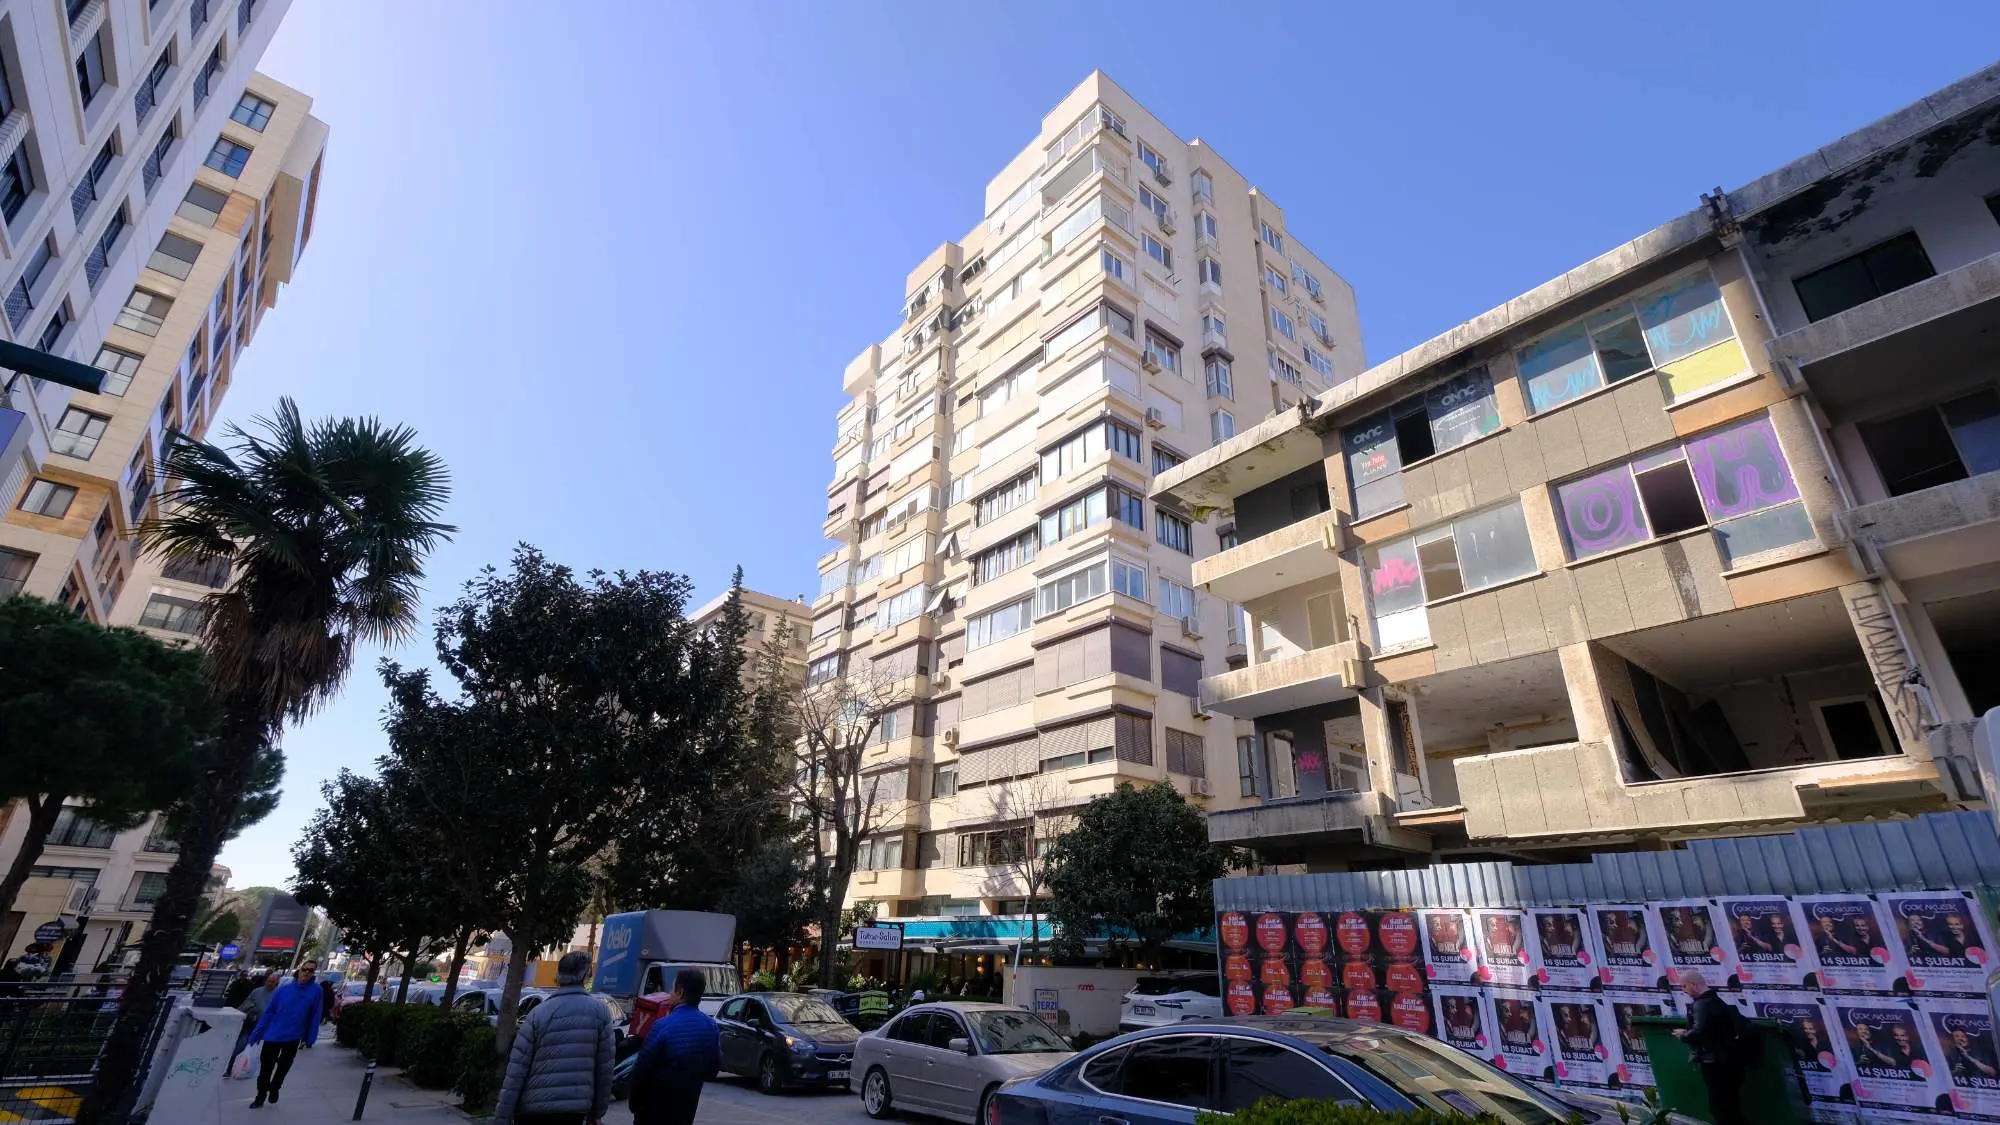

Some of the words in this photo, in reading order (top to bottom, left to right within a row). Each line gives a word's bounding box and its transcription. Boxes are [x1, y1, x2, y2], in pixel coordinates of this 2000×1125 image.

[607, 924, 632, 949] beko
[1753, 953, 1784, 962] ŞUBAT
[1821, 957, 1833, 965] 14
[1836, 957, 1870, 967] ŞUBAT
[1924, 957, 1966, 967] ŞUBAT
[1456, 1040, 1476, 1048] ŞUBAT
[1511, 1045, 1533, 1054] ŞUBAT
[1573, 1052, 1596, 1060] ŞUBAT
[1858, 1067, 1871, 1075] 14
[1873, 1068, 1912, 1079] ŞUBAT
[1954, 1076, 1968, 1085] 14
